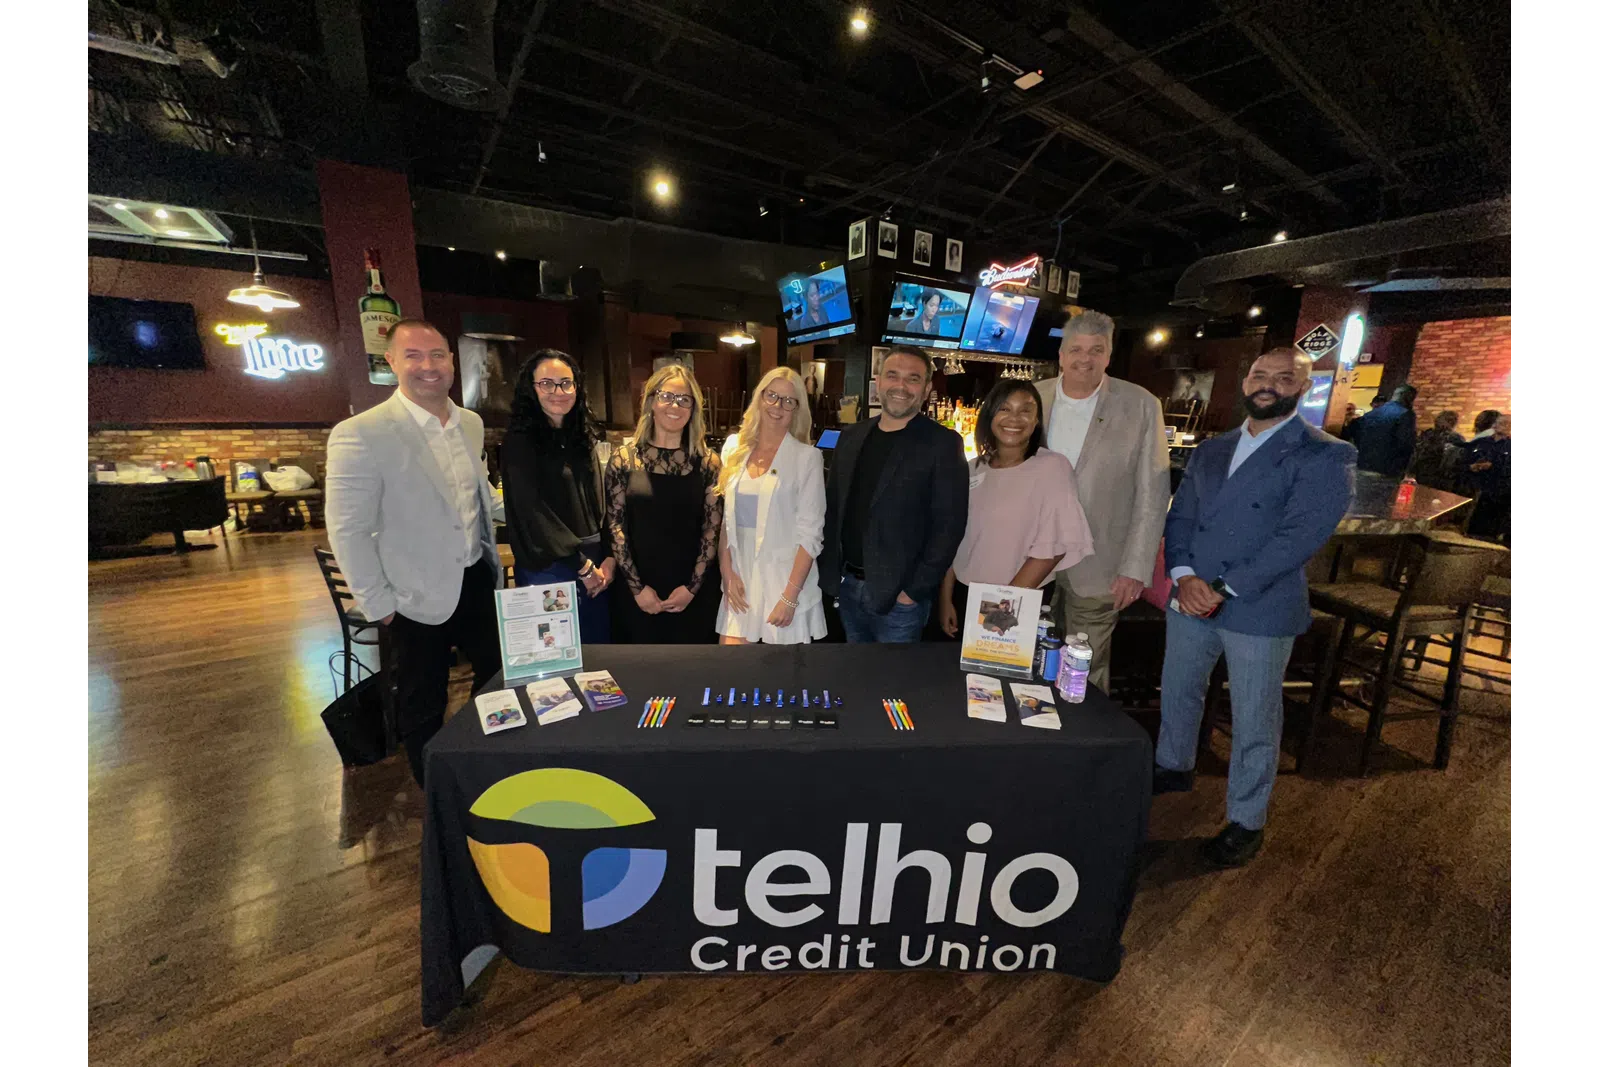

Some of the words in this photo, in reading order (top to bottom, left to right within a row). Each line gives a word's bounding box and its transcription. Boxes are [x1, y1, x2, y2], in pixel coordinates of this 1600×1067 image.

[692, 821, 1080, 928] telhio
[690, 933, 876, 972] Credit
[899, 934, 1057, 972] Union
